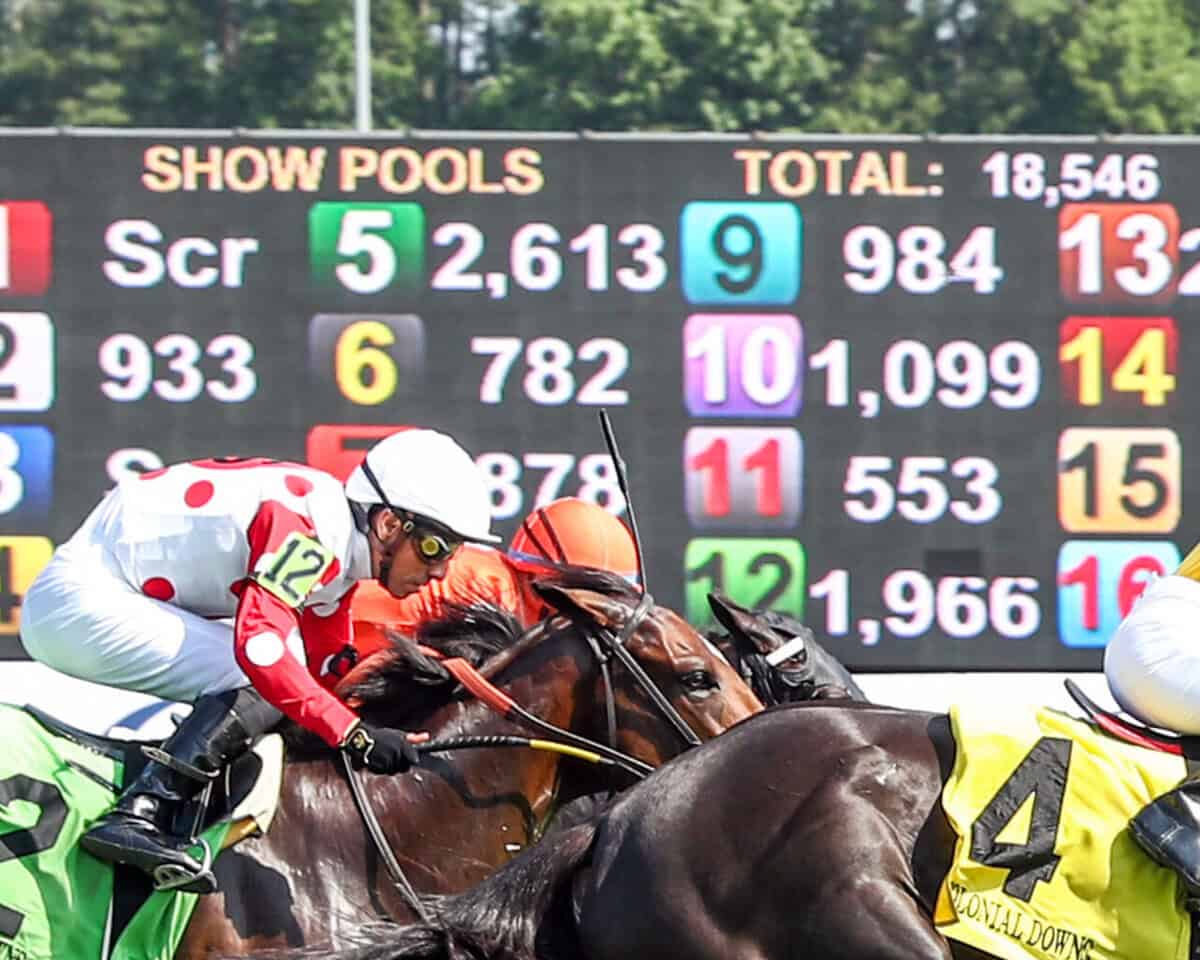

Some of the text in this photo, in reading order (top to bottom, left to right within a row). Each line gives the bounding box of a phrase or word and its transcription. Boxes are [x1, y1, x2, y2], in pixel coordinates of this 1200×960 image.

[141, 146, 544, 194] SHOW POOLS
[734, 151, 1160, 206] TOTAL: 18,546
[103, 219, 259, 288] Scr
[335, 210, 668, 299] 5 2,613
[711, 216, 1004, 294] 9 984
[1059, 213, 1174, 295] 13
[98, 334, 257, 403] 933
[335, 321, 630, 405] 6 782
[687, 327, 1041, 417] 10 1,099
[1059, 327, 1175, 406] 14
[688, 437, 1002, 524] 11 553
[1064, 444, 1166, 518] 15
[264, 538, 325, 601] 12
[809, 570, 1041, 643] 1,966
[968, 736, 1073, 903] 4
